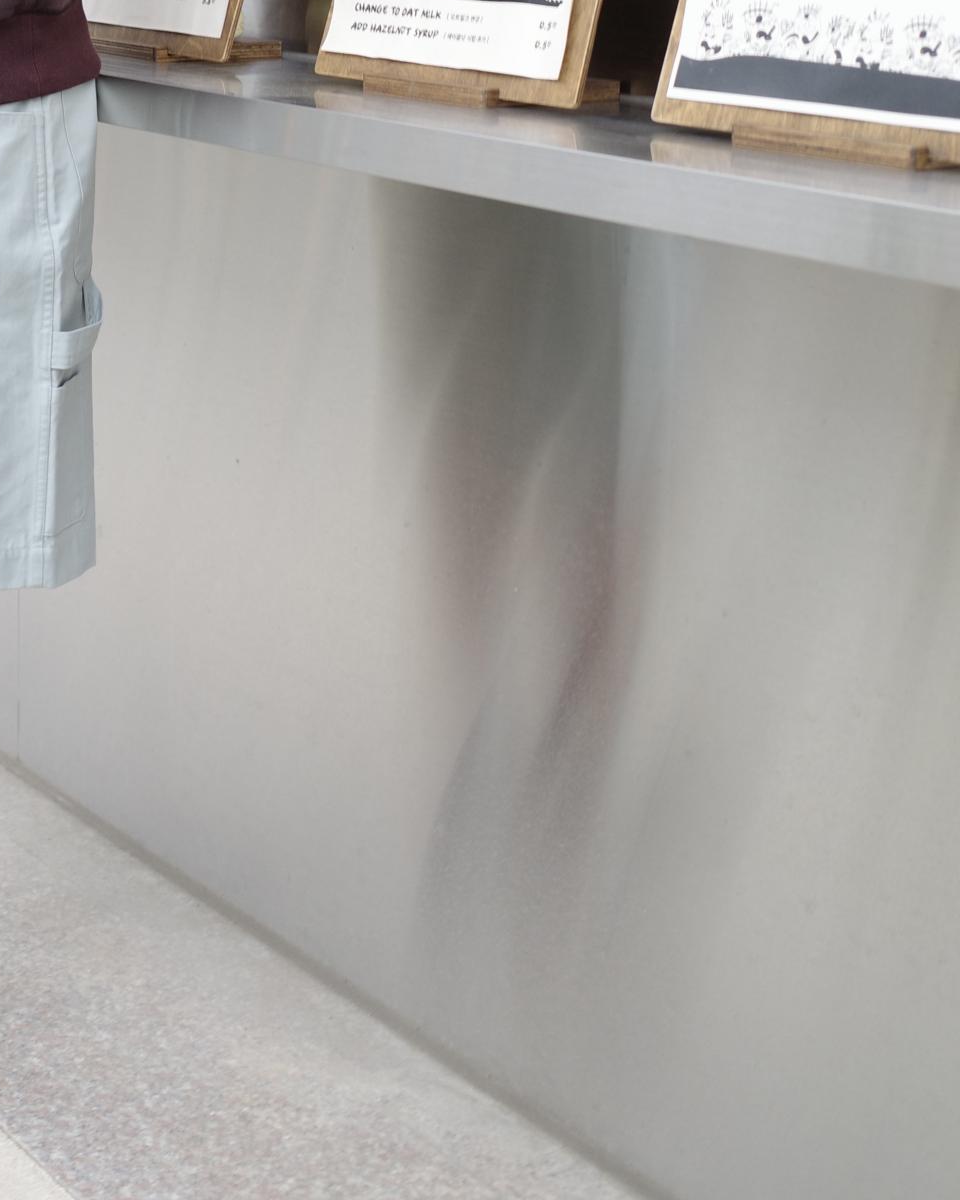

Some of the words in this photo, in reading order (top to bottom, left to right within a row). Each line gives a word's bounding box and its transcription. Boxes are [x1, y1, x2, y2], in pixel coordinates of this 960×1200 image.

[355, 2, 389, 14] CHANGE
[391, 5, 401, 16] TO
[351, 21, 368, 31] ADD
[413, 28, 439, 39] SYRUP
